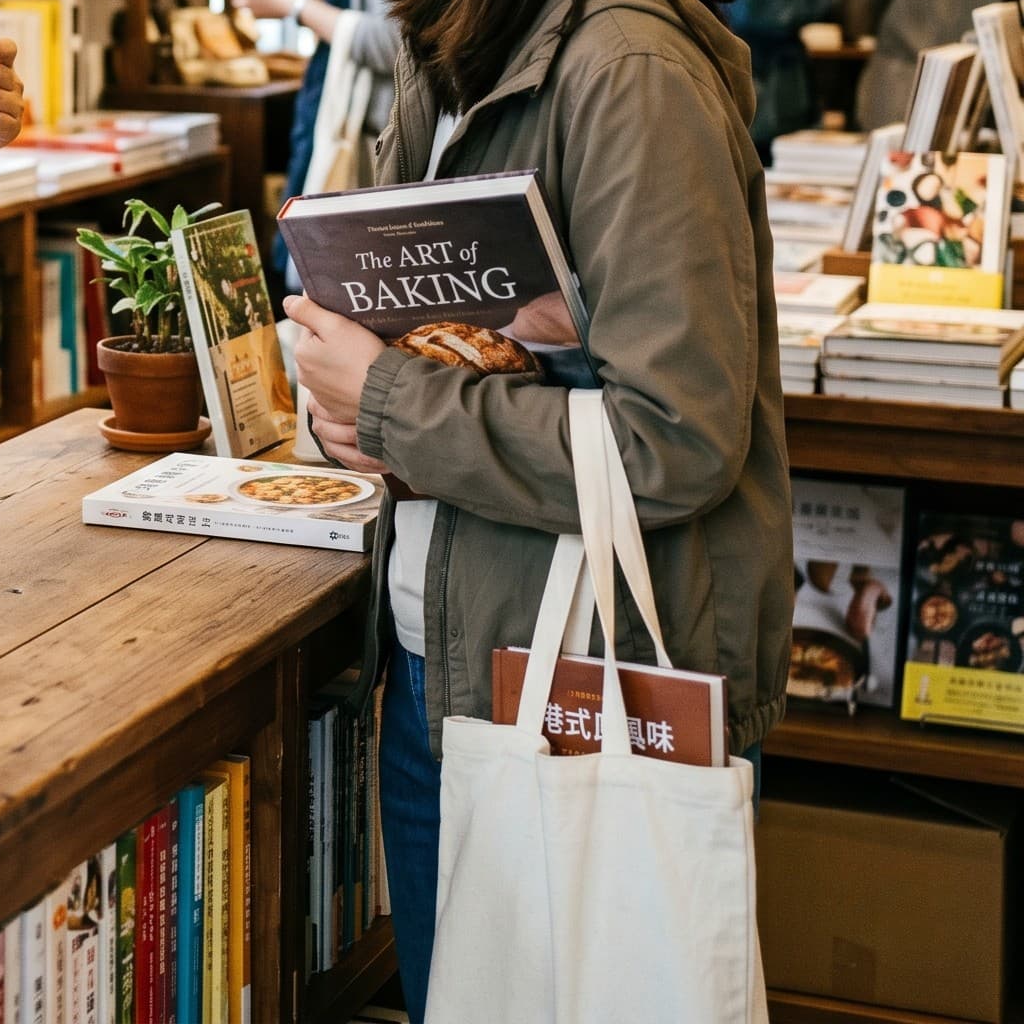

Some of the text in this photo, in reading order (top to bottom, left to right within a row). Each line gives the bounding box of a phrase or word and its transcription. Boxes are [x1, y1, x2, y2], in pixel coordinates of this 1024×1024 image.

[355, 240, 479, 271] The ART of
[341, 266, 517, 313] BAKING
